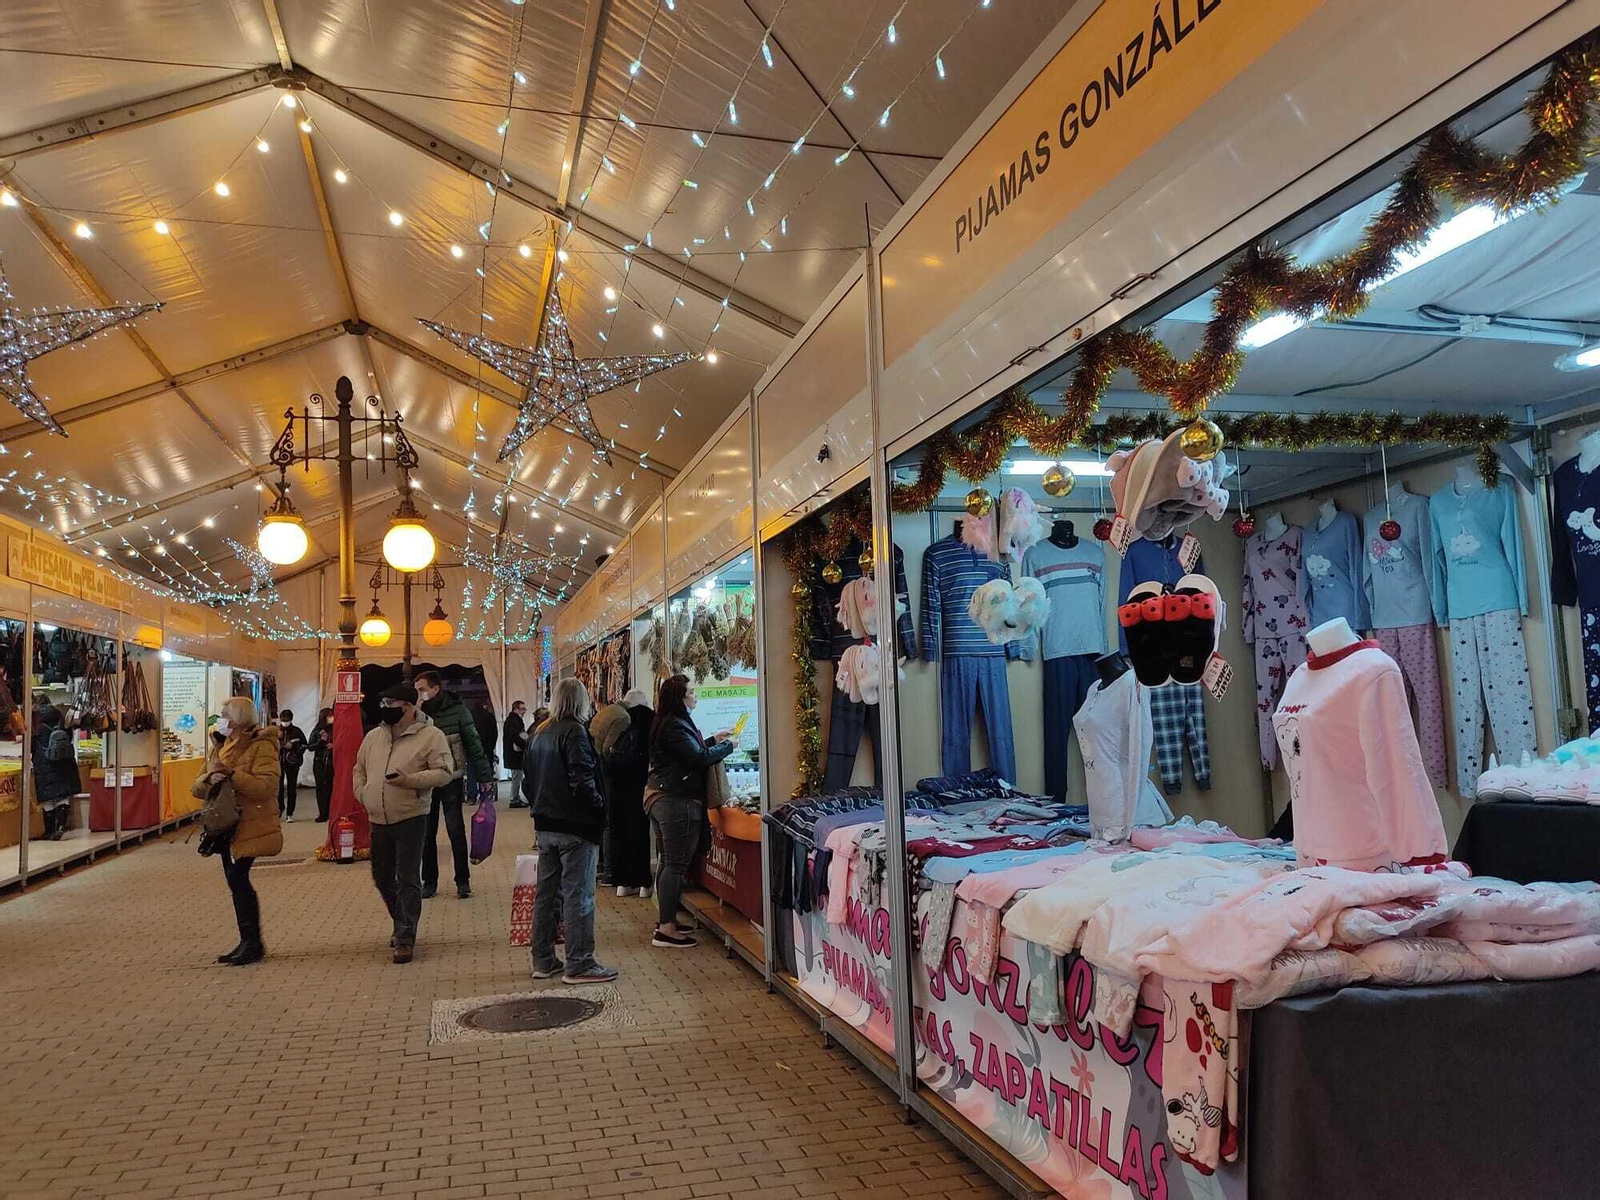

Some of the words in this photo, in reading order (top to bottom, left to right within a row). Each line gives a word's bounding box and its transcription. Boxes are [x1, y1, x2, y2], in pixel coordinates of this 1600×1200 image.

[956, 131, 1050, 252] PIJAMAS
[701, 690, 712, 698] DE
[716, 688, 748, 698] MASAJE
[1212, 662, 1229, 694] SHOES
[969, 1031, 1168, 1200] ZAPATILLAS
